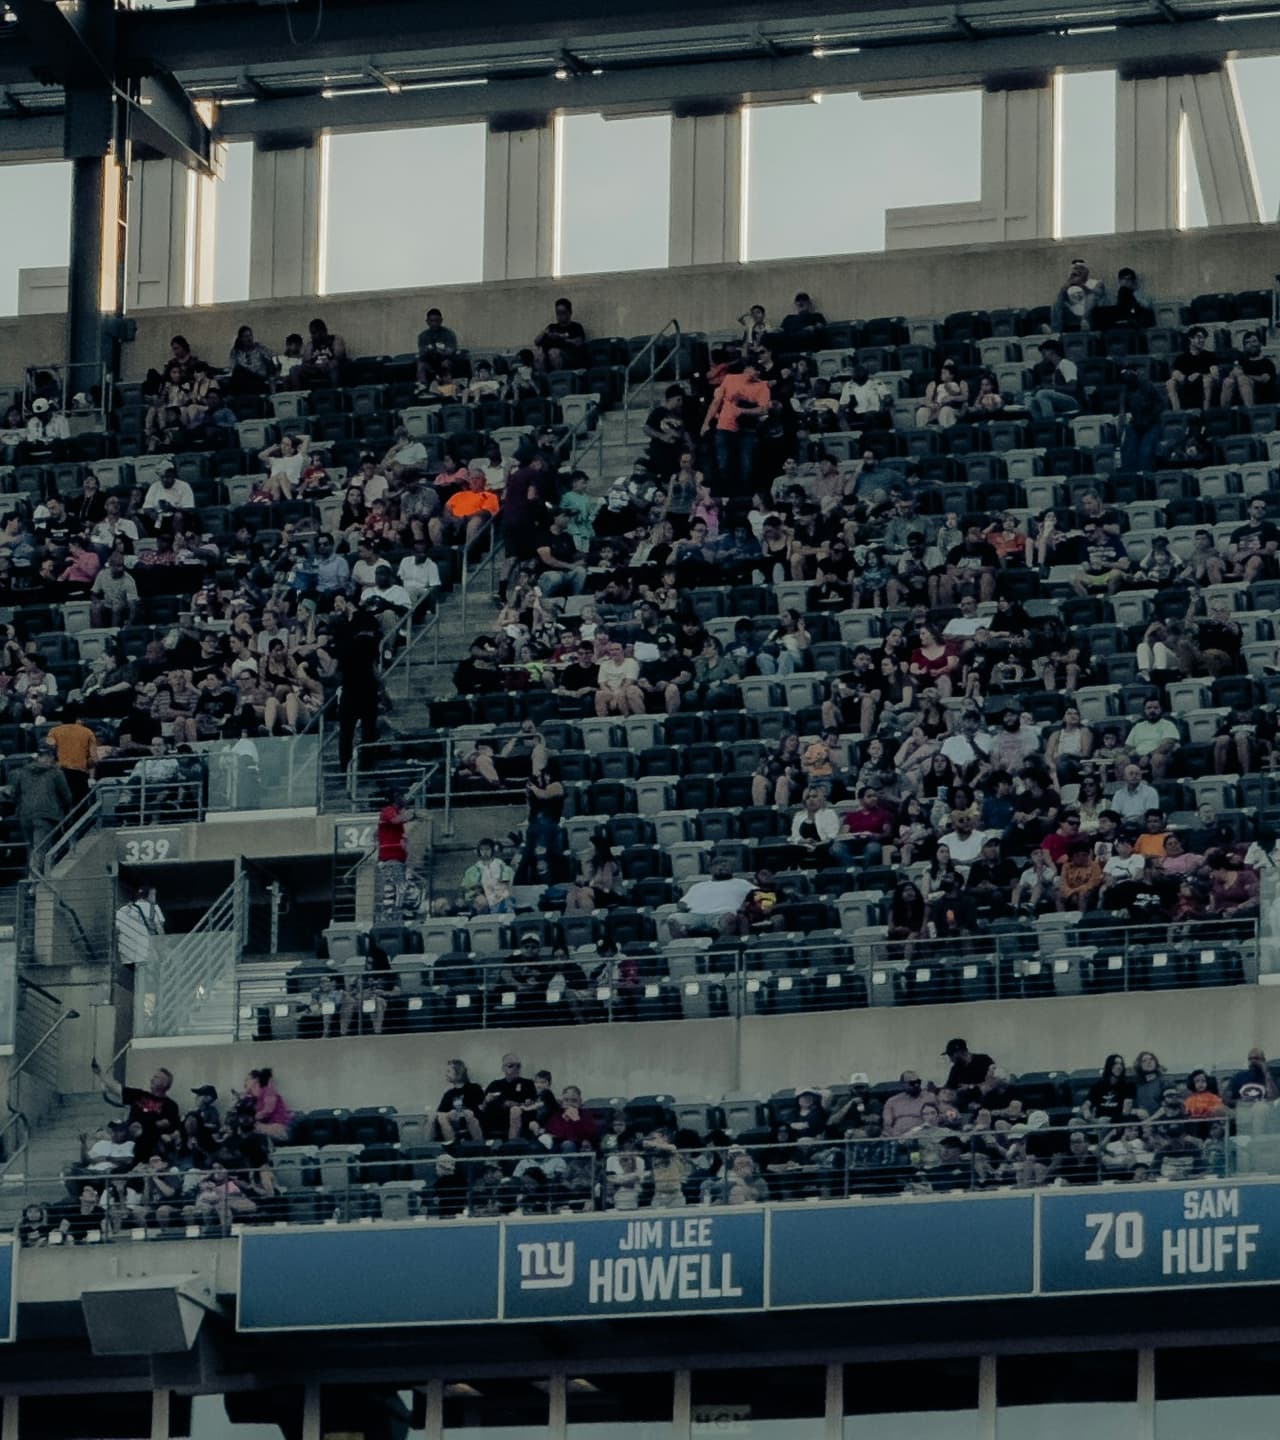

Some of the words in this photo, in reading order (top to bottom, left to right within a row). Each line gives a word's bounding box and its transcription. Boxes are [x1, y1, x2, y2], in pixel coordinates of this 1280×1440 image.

[126, 840, 170, 861] 339
[1183, 1189, 1239, 1220] SAM
[619, 1221, 662, 1250] JIM
[670, 1218, 713, 1248] LEE
[1085, 1211, 1143, 1260] 70
[1162, 1224, 1259, 1275] HUFF
[589, 1253, 743, 1303] HOWELL
